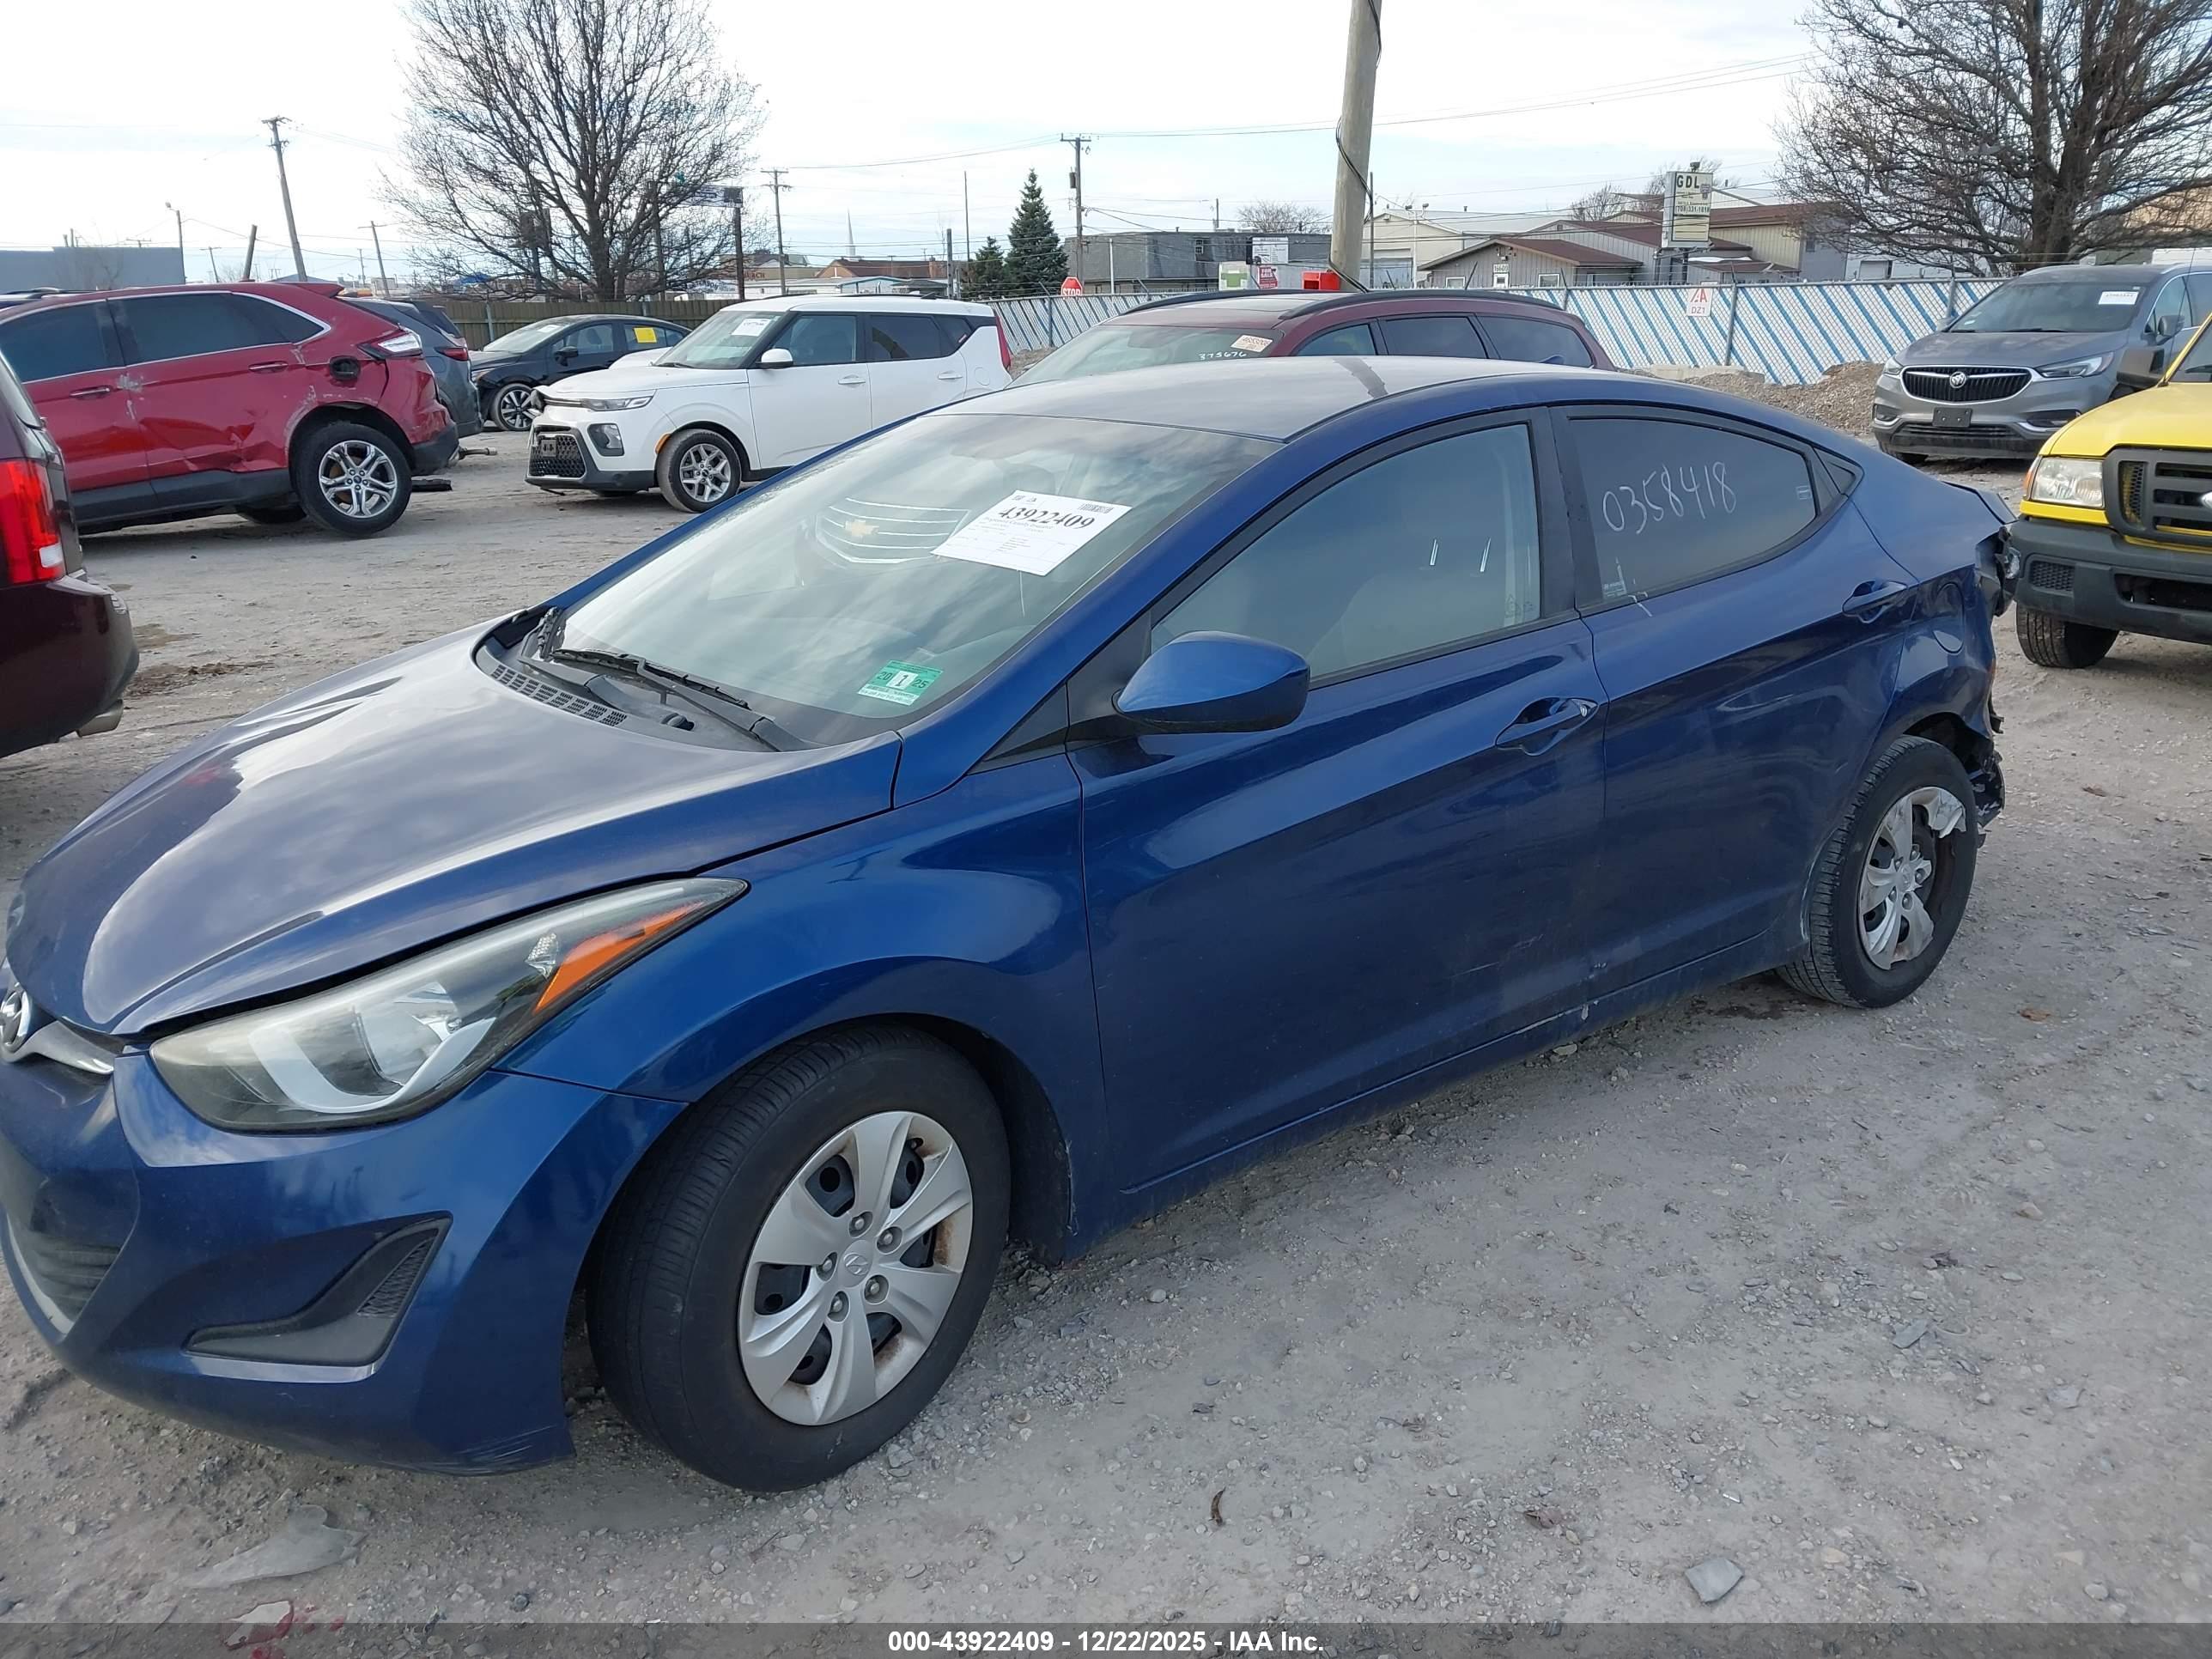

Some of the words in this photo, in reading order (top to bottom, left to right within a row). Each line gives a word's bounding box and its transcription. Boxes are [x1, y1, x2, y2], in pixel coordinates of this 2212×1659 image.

[1676, 174, 1699, 188] GDL
[1062, 288, 1082, 296] STOP
[1691, 306, 1705, 314] DZ1
[1602, 461, 1737, 534] 0358418
[998, 506, 1096, 530] 43922409
[877, 671, 894, 681] 20
[894, 674, 909, 687] 1
[911, 678, 929, 689] 25
